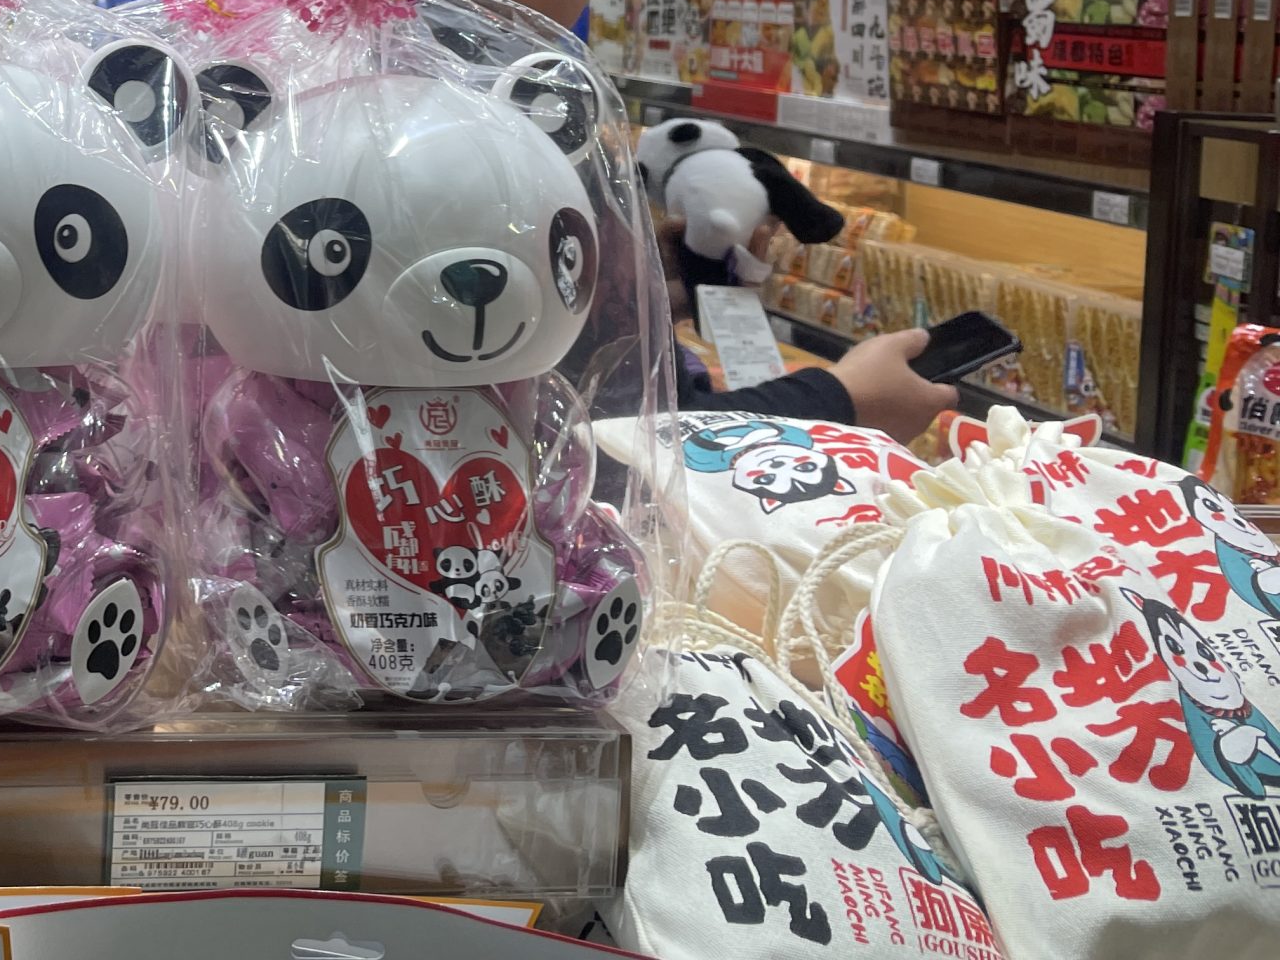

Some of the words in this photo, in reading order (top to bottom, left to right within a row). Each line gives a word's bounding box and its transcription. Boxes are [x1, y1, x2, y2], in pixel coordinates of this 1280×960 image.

[350, 612, 439, 629] 奶香巧克力味
[1215, 632, 1254, 672] MING
[368, 654, 415, 671] 408克
[149, 795, 210, 811] ¥79.00
[959, 636, 1161, 902] 名小吃
[334, 789, 353, 883] 商品标价签
[646, 693, 832, 946] 名小吃
[1154, 805, 1203, 892] XIAOCHI
[1174, 804, 1214, 861] MING
[1195, 802, 1240, 883] DIFANG
[830, 857, 870, 945] XIAOCHI
[848, 862, 881, 919] MING
[866, 866, 906, 946] DIFANG
